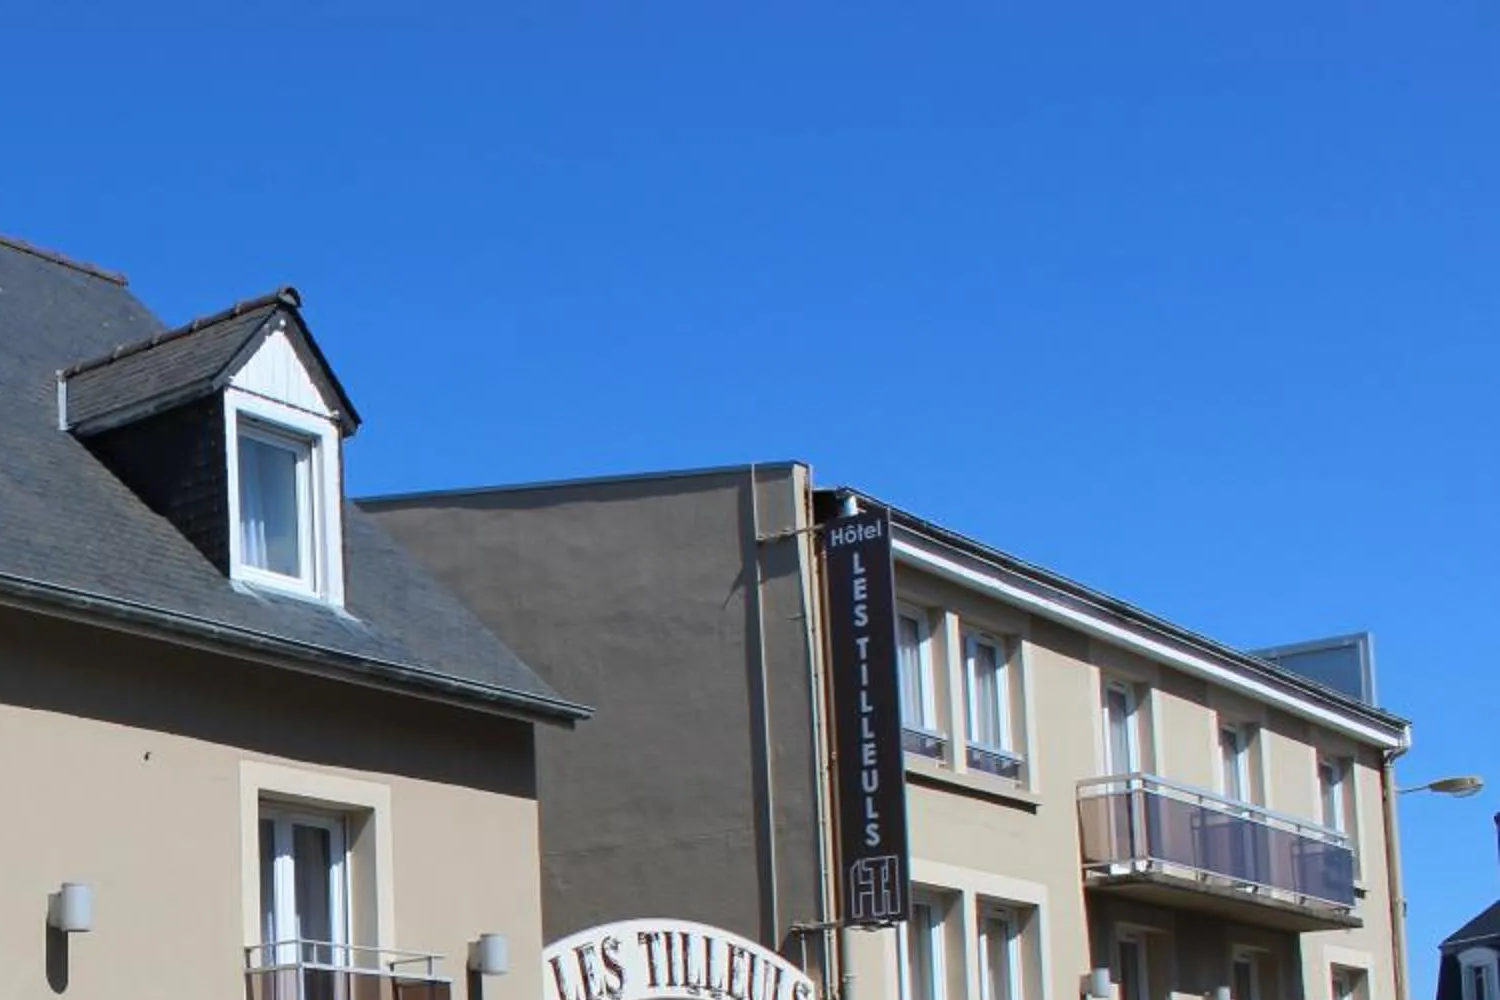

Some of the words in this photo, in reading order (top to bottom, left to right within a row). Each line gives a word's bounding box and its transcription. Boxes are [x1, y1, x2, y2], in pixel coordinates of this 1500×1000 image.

[831, 519, 881, 547] Hôtel
[853, 551, 869, 627] LES
[856, 636, 881, 846] TILLEULS
